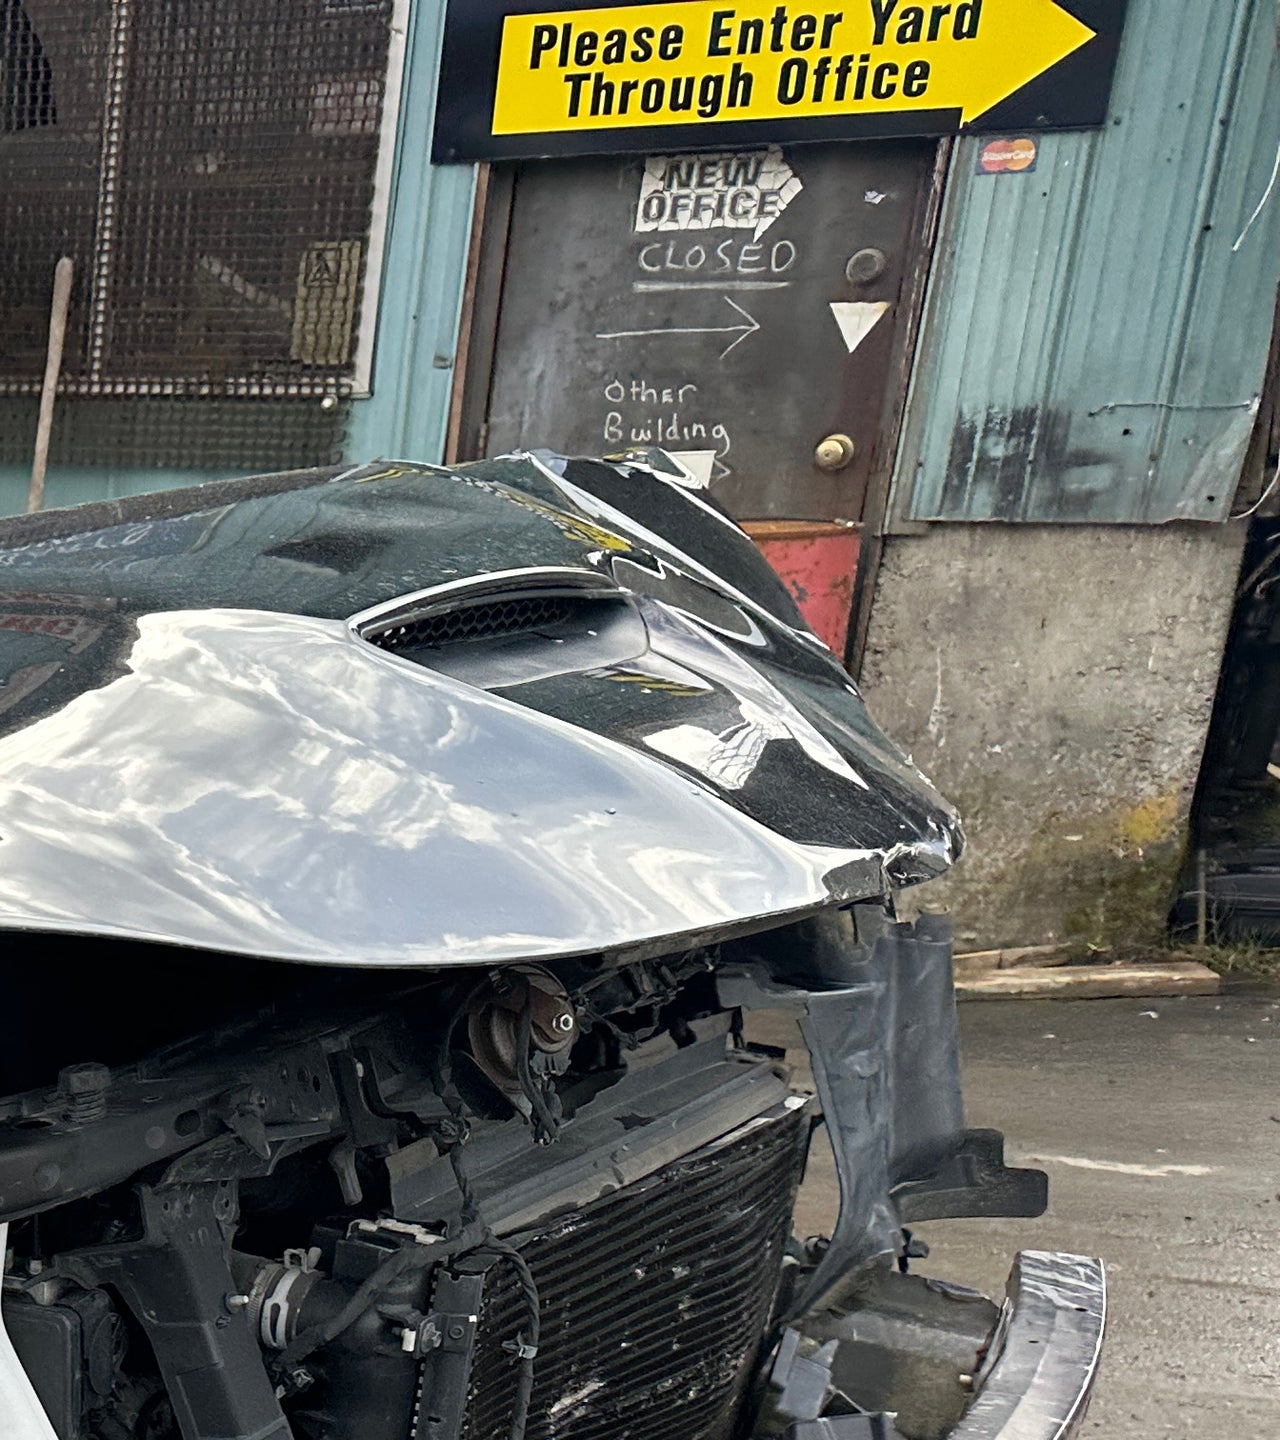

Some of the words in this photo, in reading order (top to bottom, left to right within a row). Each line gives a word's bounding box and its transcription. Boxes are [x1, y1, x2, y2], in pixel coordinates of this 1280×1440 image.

[529, 23, 684, 70] Please
[706, 6, 843, 57] Enter
[870, 0, 982, 46] Yard
[564, 63, 754, 119] Through
[777, 53, 931, 105] Office
[664, 155, 763, 191] NEW
[642, 188, 781, 224] OFFICE
[639, 238, 796, 275] CLOSED
[604, 379, 698, 404] Other
[604, 411, 731, 459] Building
